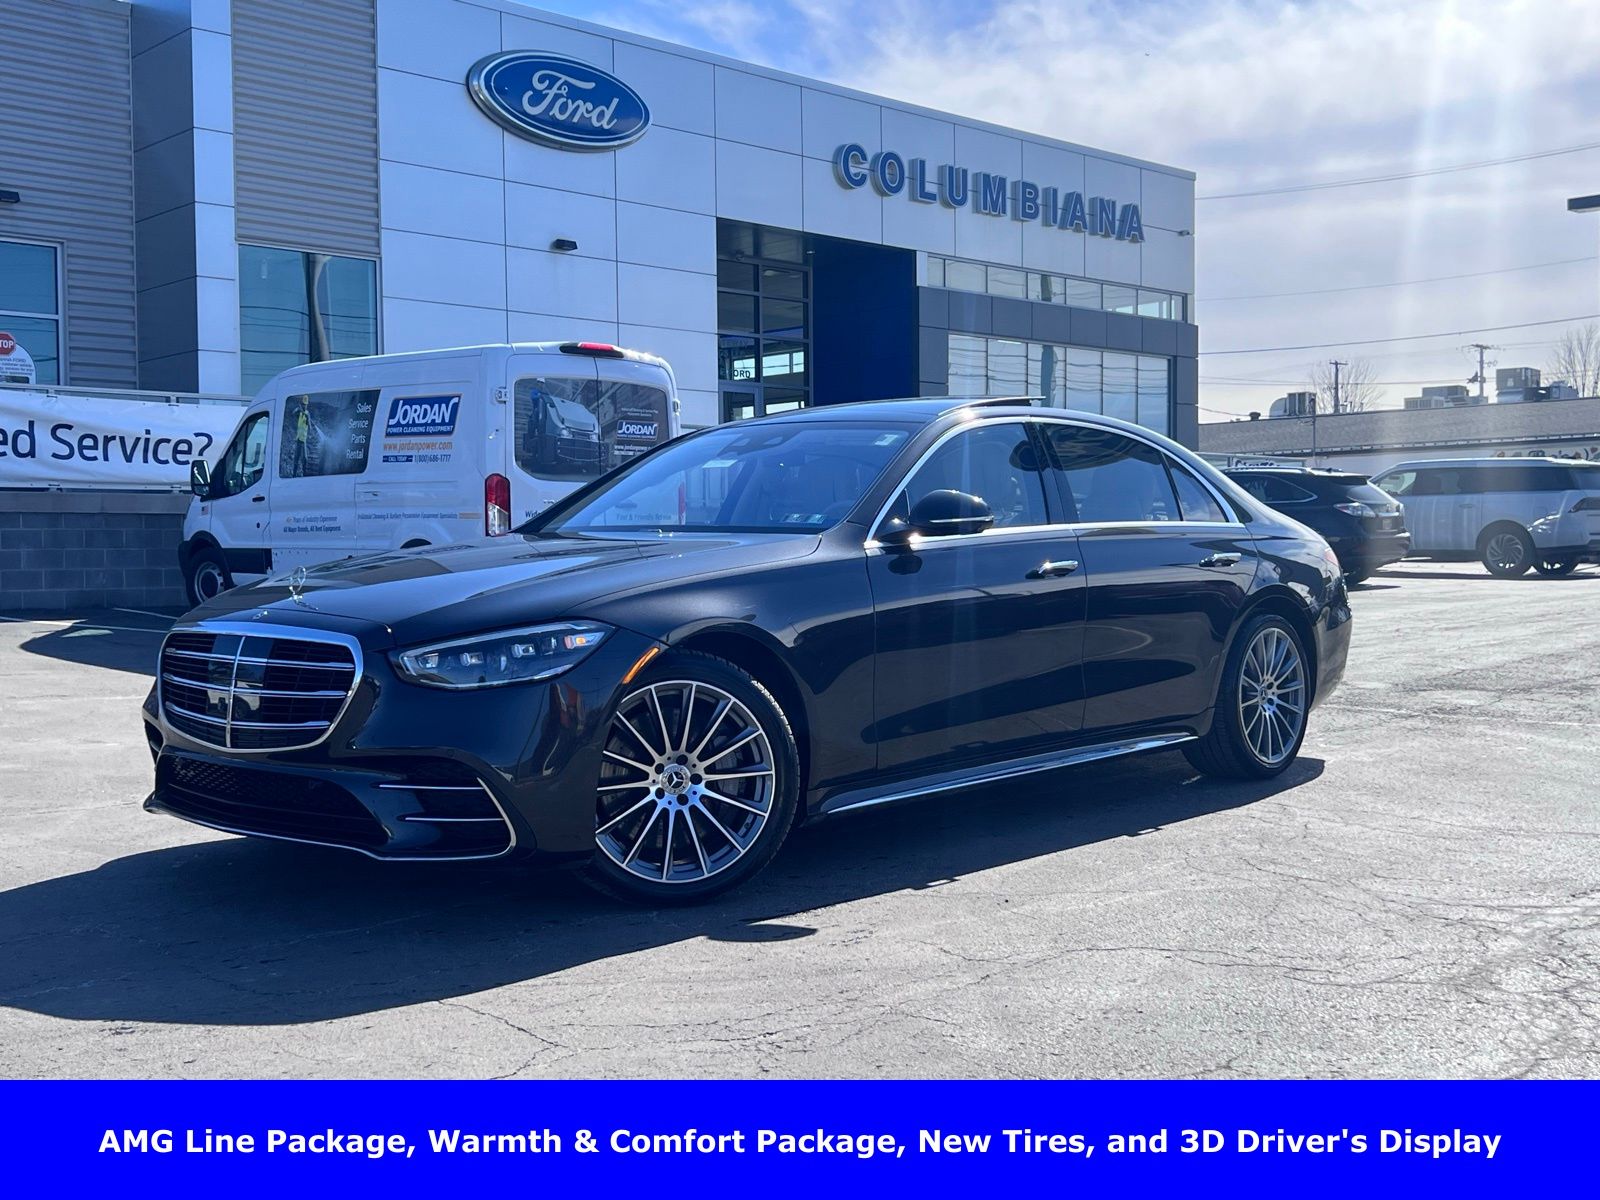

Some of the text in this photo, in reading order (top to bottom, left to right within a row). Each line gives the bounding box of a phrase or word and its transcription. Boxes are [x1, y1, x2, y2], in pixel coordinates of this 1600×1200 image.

[522, 70, 620, 130] Ford
[833, 142, 1145, 243] COLUMBIANA
[357, 402, 372, 414] Sales
[388, 397, 460, 426] JORDAN
[349, 419, 369, 429] Service
[618, 421, 658, 435] JORDAN
[50, 423, 214, 465] Service?
[352, 433, 366, 444] Parts
[346, 448, 364, 459] Rental
[383, 439, 453, 454] www.jordanpower.com
